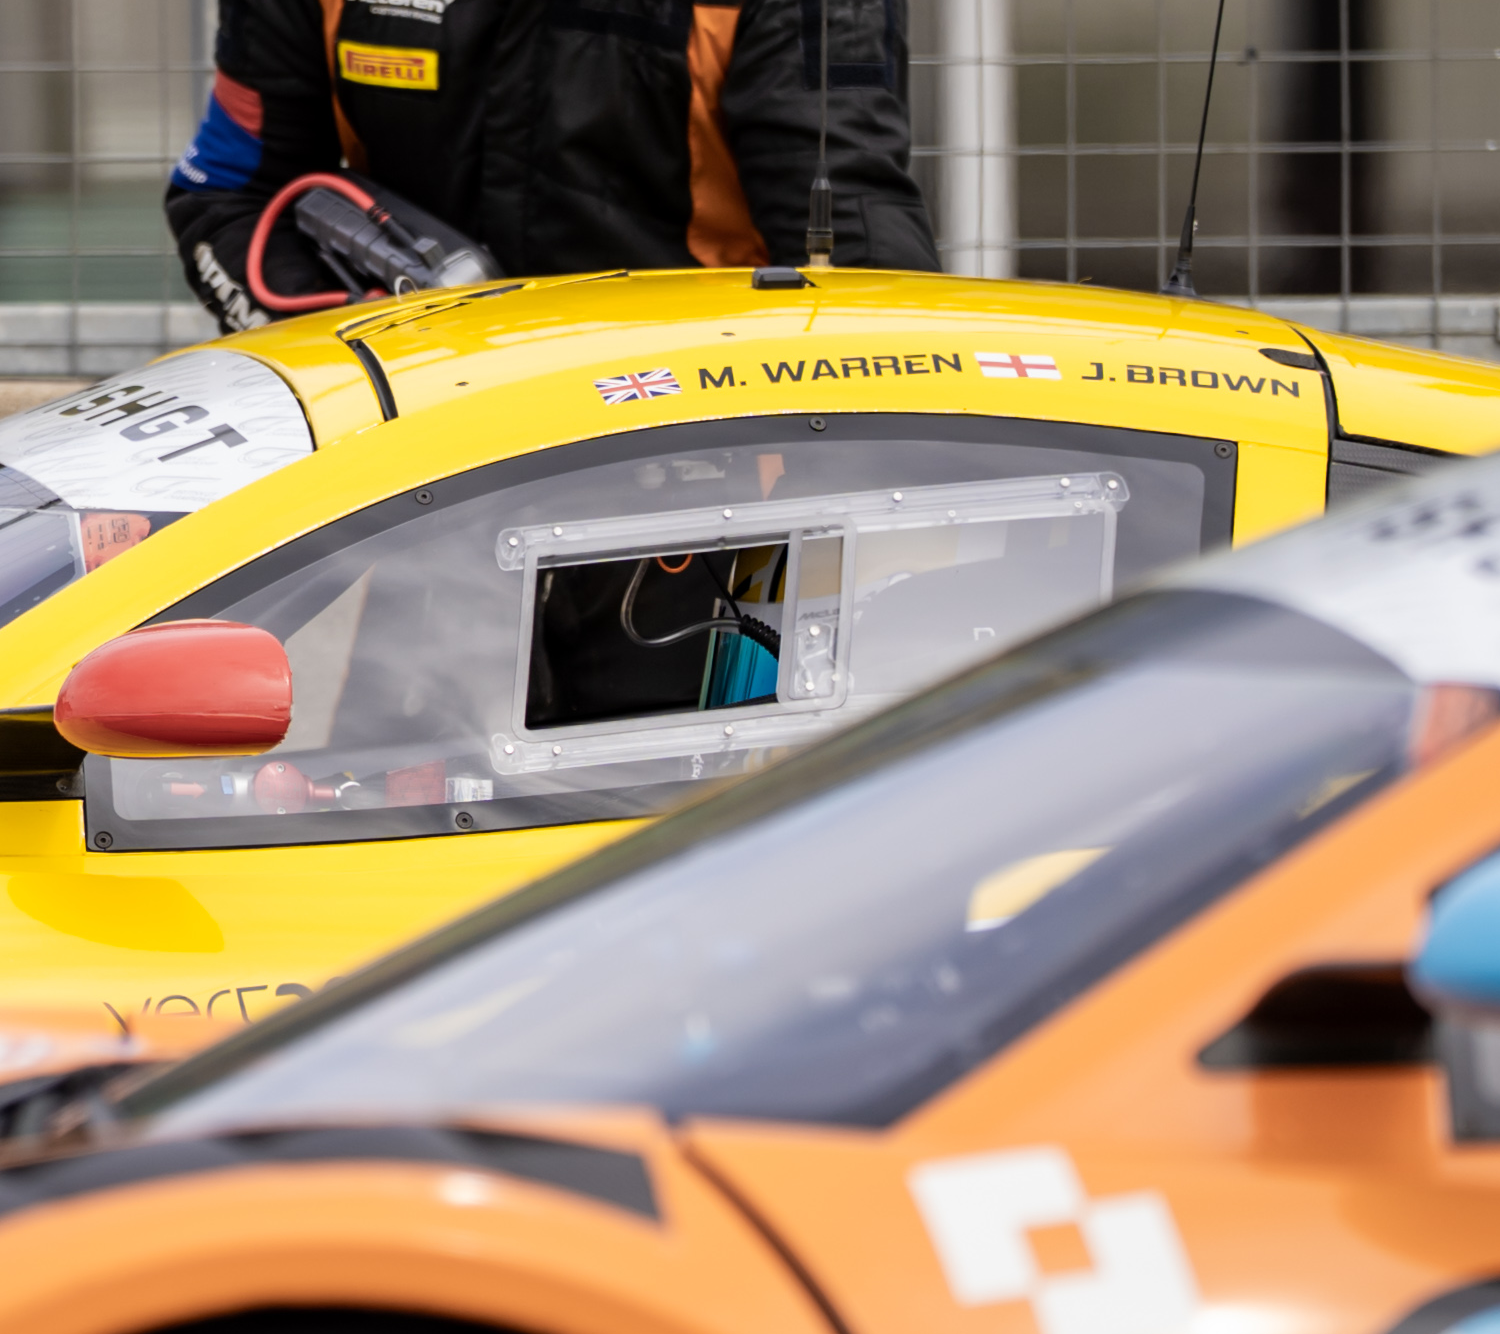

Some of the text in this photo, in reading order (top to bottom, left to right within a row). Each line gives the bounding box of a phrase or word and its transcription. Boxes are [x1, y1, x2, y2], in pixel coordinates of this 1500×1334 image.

[346, 50, 426, 82] PIRELLI
[698, 353, 1301, 399] M. WARREN J. BROWN
